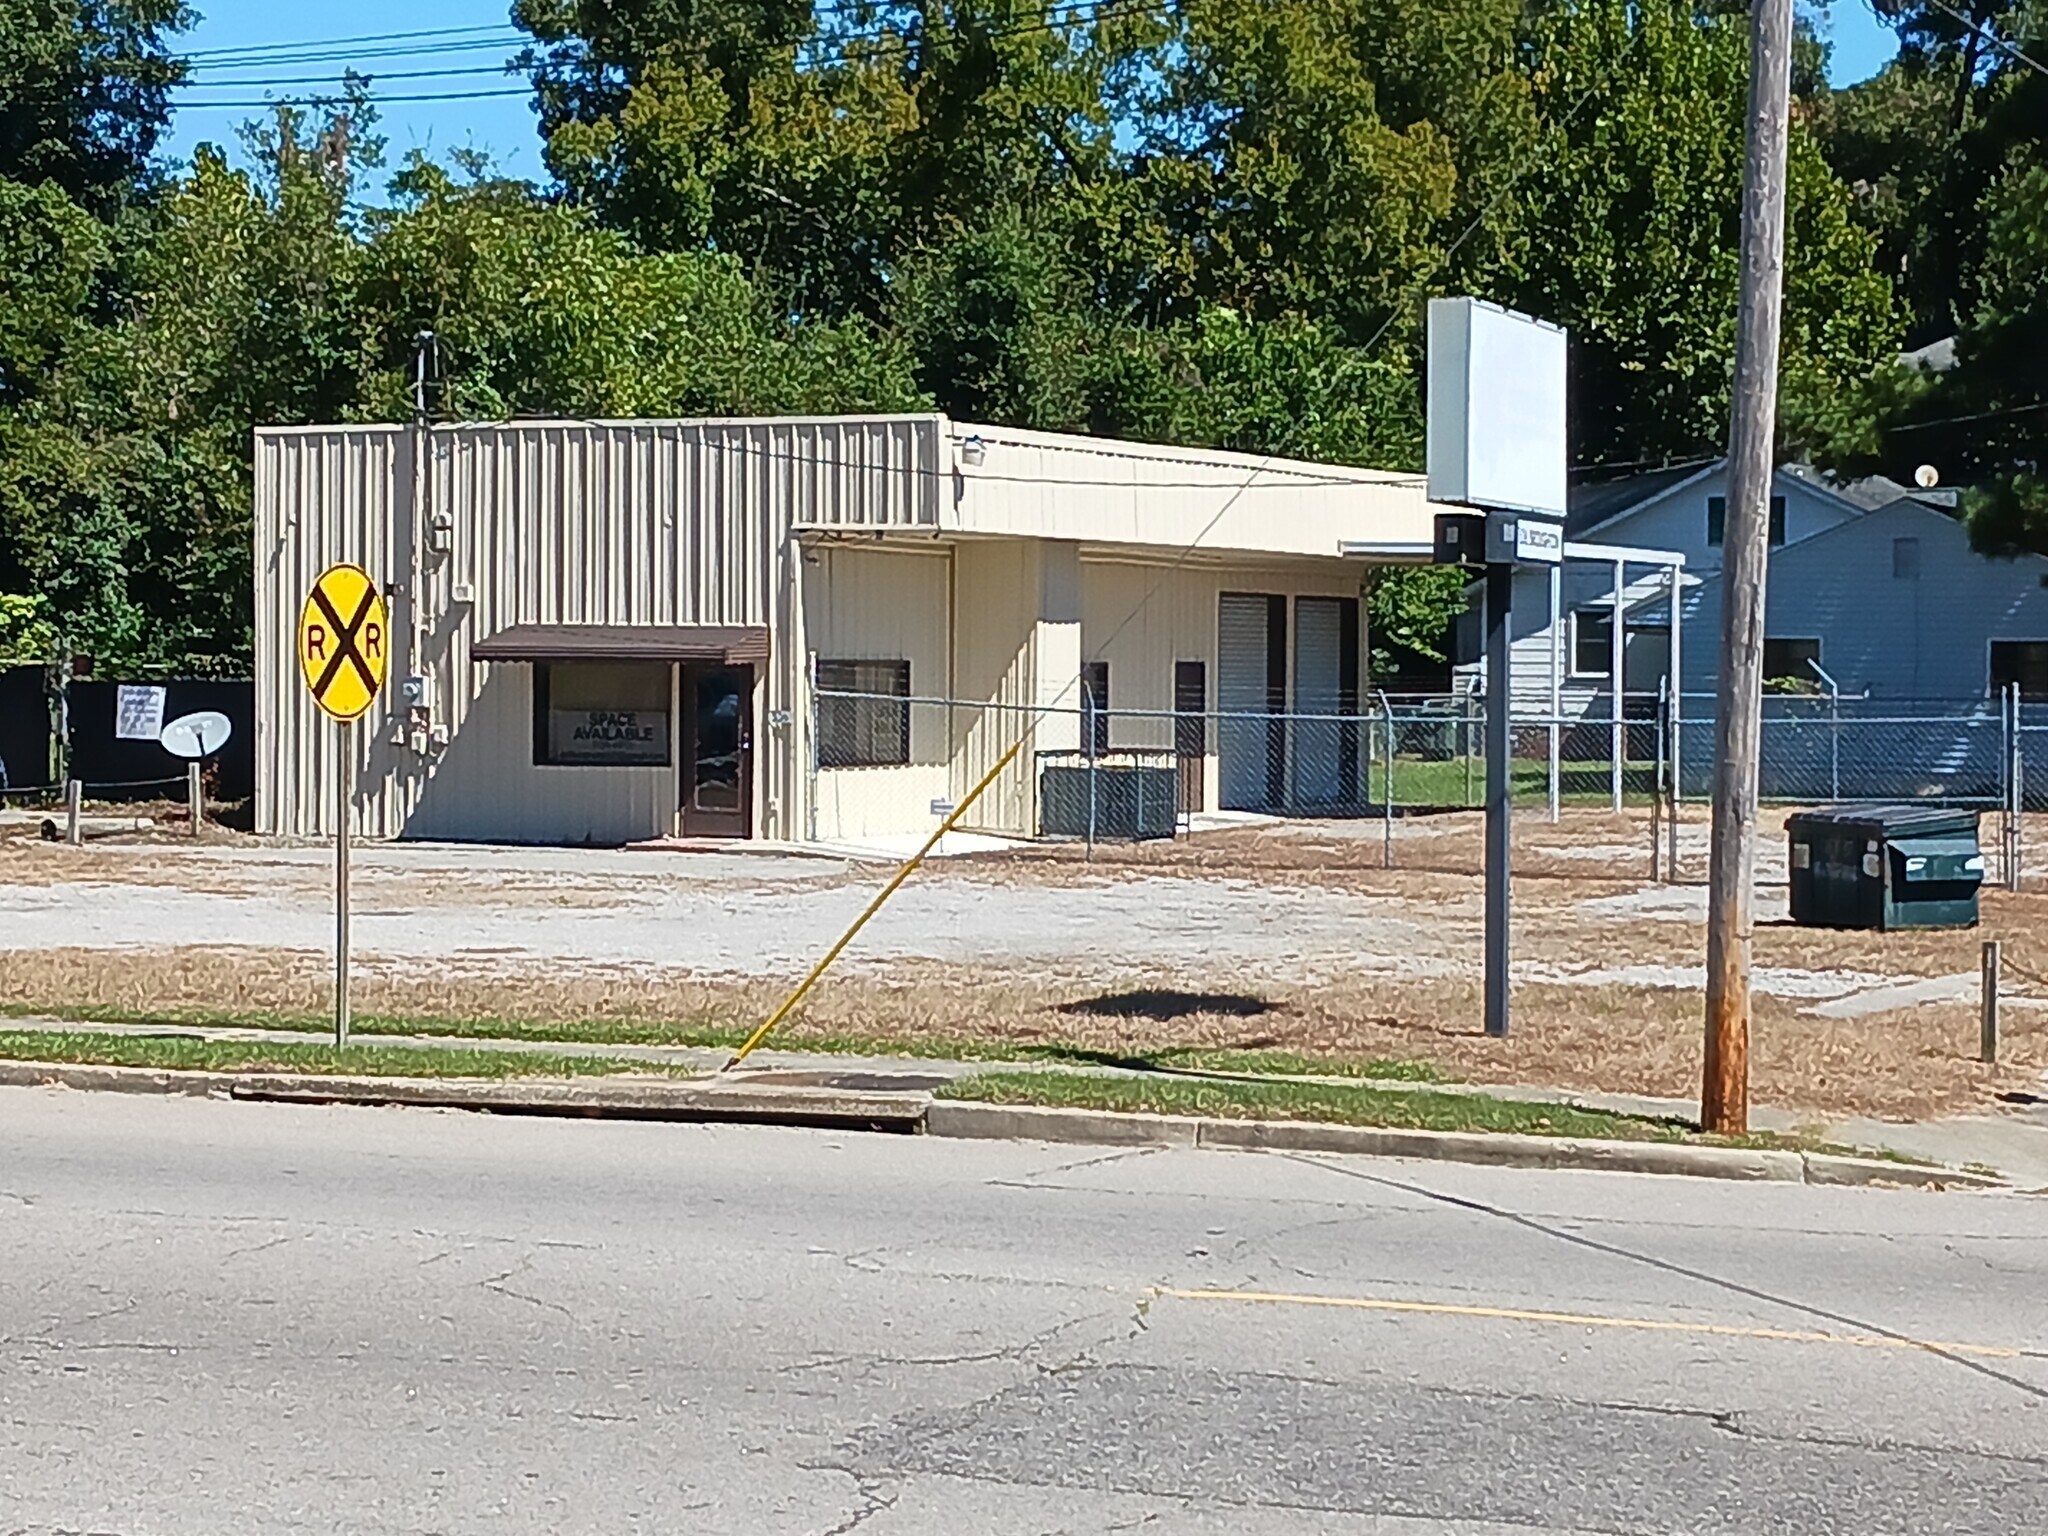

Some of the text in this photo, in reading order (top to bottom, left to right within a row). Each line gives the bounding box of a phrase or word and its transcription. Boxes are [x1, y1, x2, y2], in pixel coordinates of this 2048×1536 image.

[308, 622, 381, 661] R R
[588, 711, 637, 727] SPACE
[572, 726, 655, 742] AVAILABLE
